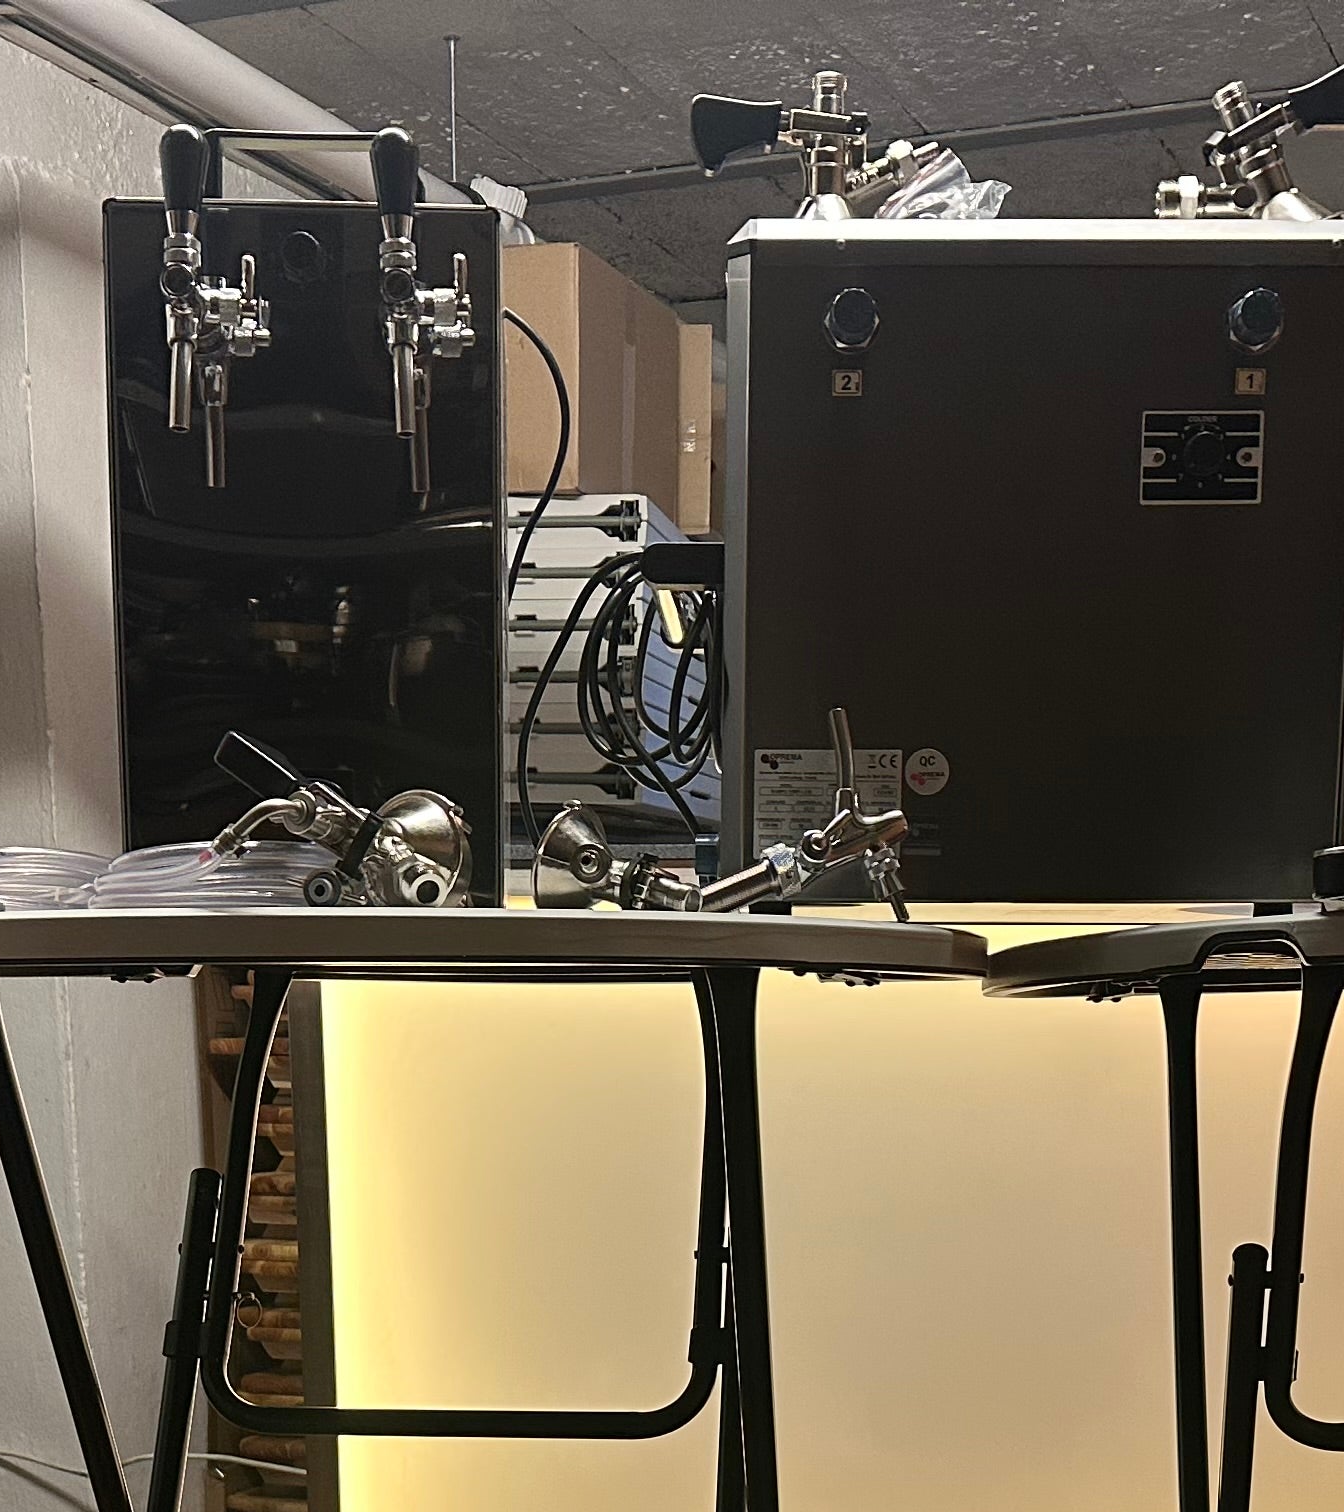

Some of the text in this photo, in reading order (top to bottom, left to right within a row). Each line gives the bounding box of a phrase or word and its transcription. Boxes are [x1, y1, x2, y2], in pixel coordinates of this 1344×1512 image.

[841, 374, 852, 390] 2
[1246, 373, 1254, 389] 1
[919, 755, 936, 767] QC
